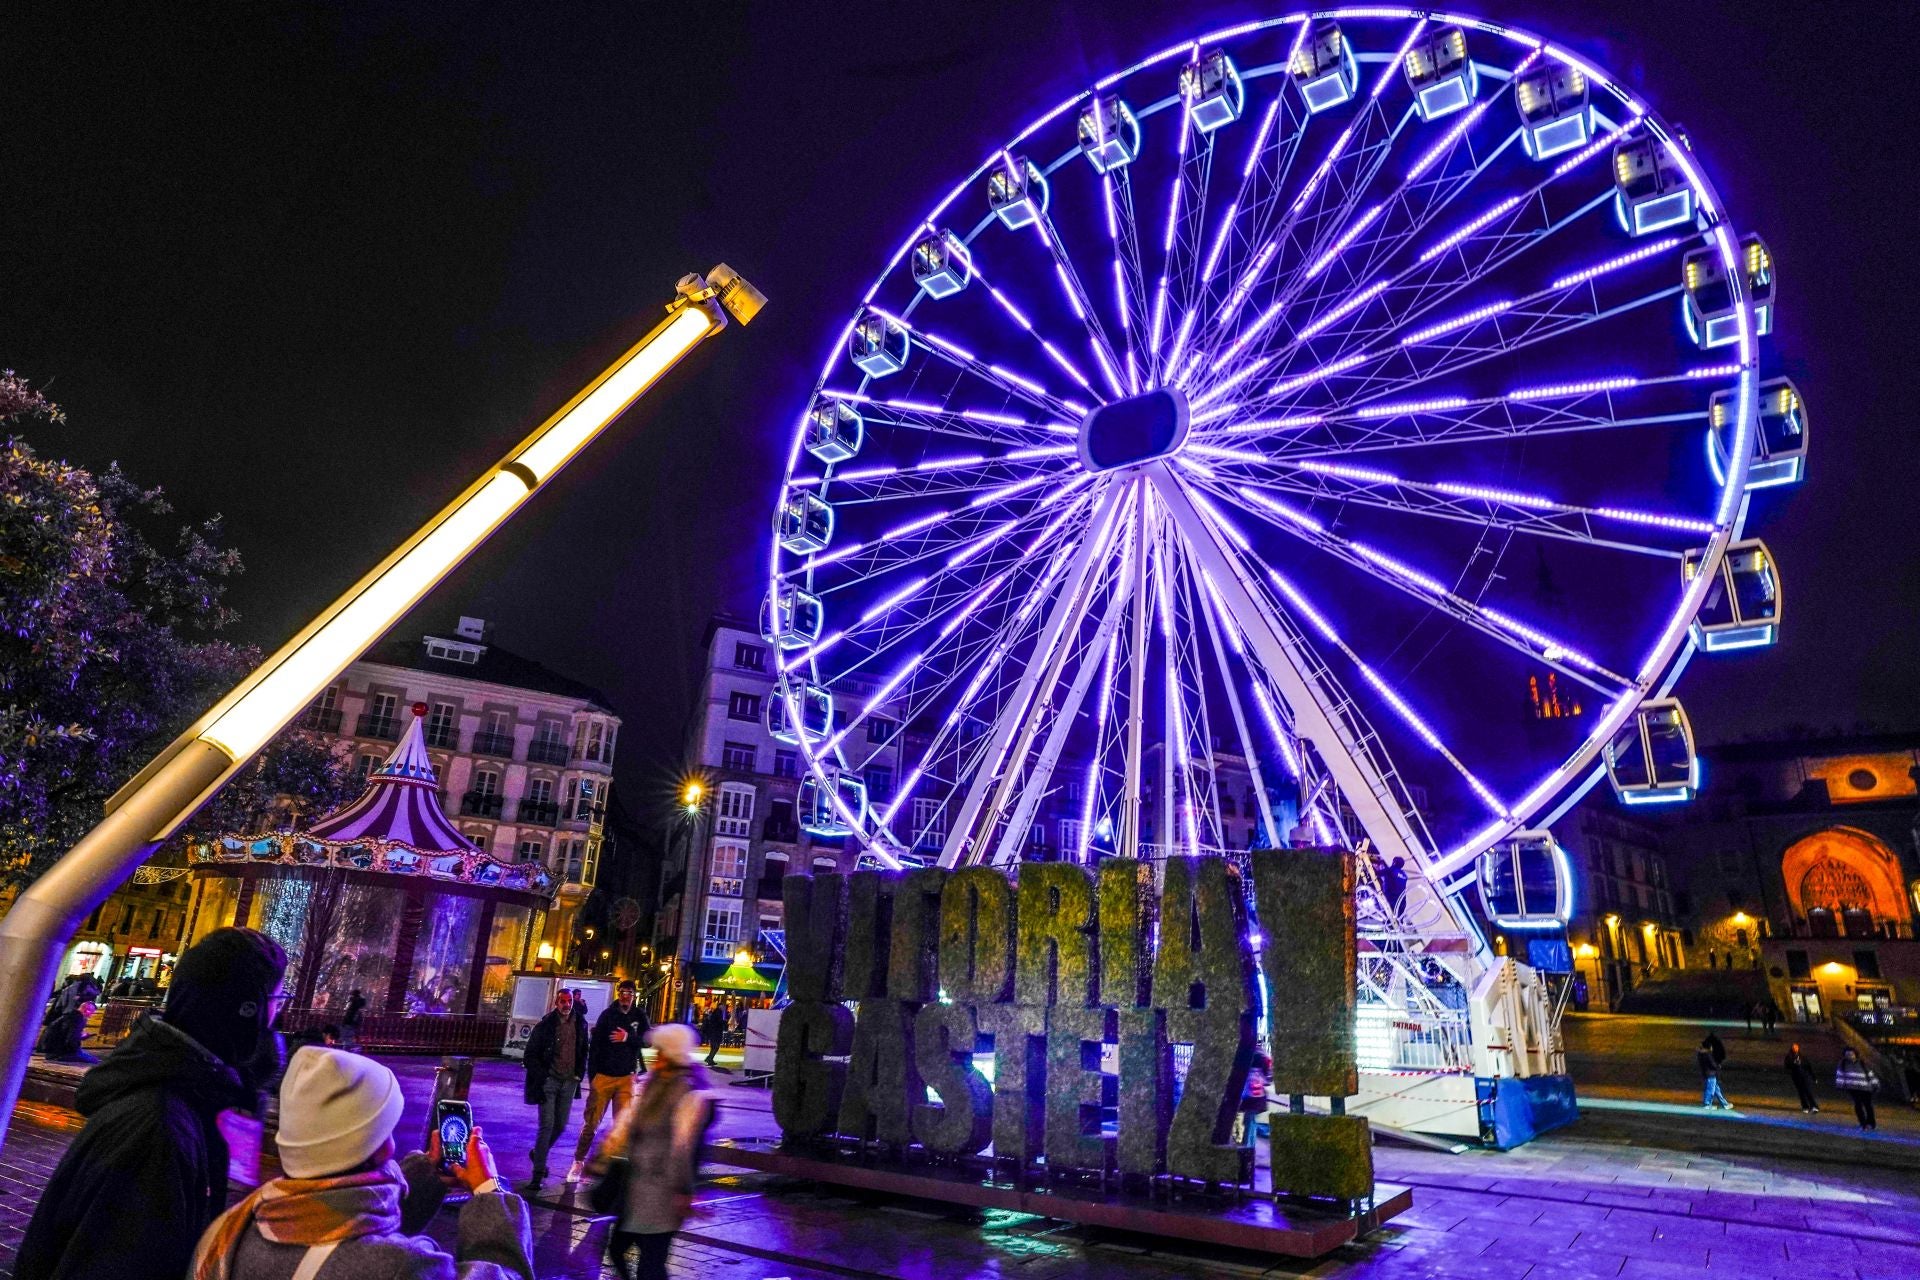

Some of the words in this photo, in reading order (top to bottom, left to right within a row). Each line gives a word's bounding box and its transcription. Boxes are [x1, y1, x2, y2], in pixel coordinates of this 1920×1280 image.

[781, 854, 1252, 1010] VITORIA
[772, 999, 1255, 1184] GASTEIZ
[1392, 1020, 1422, 1032] ENTRADA
